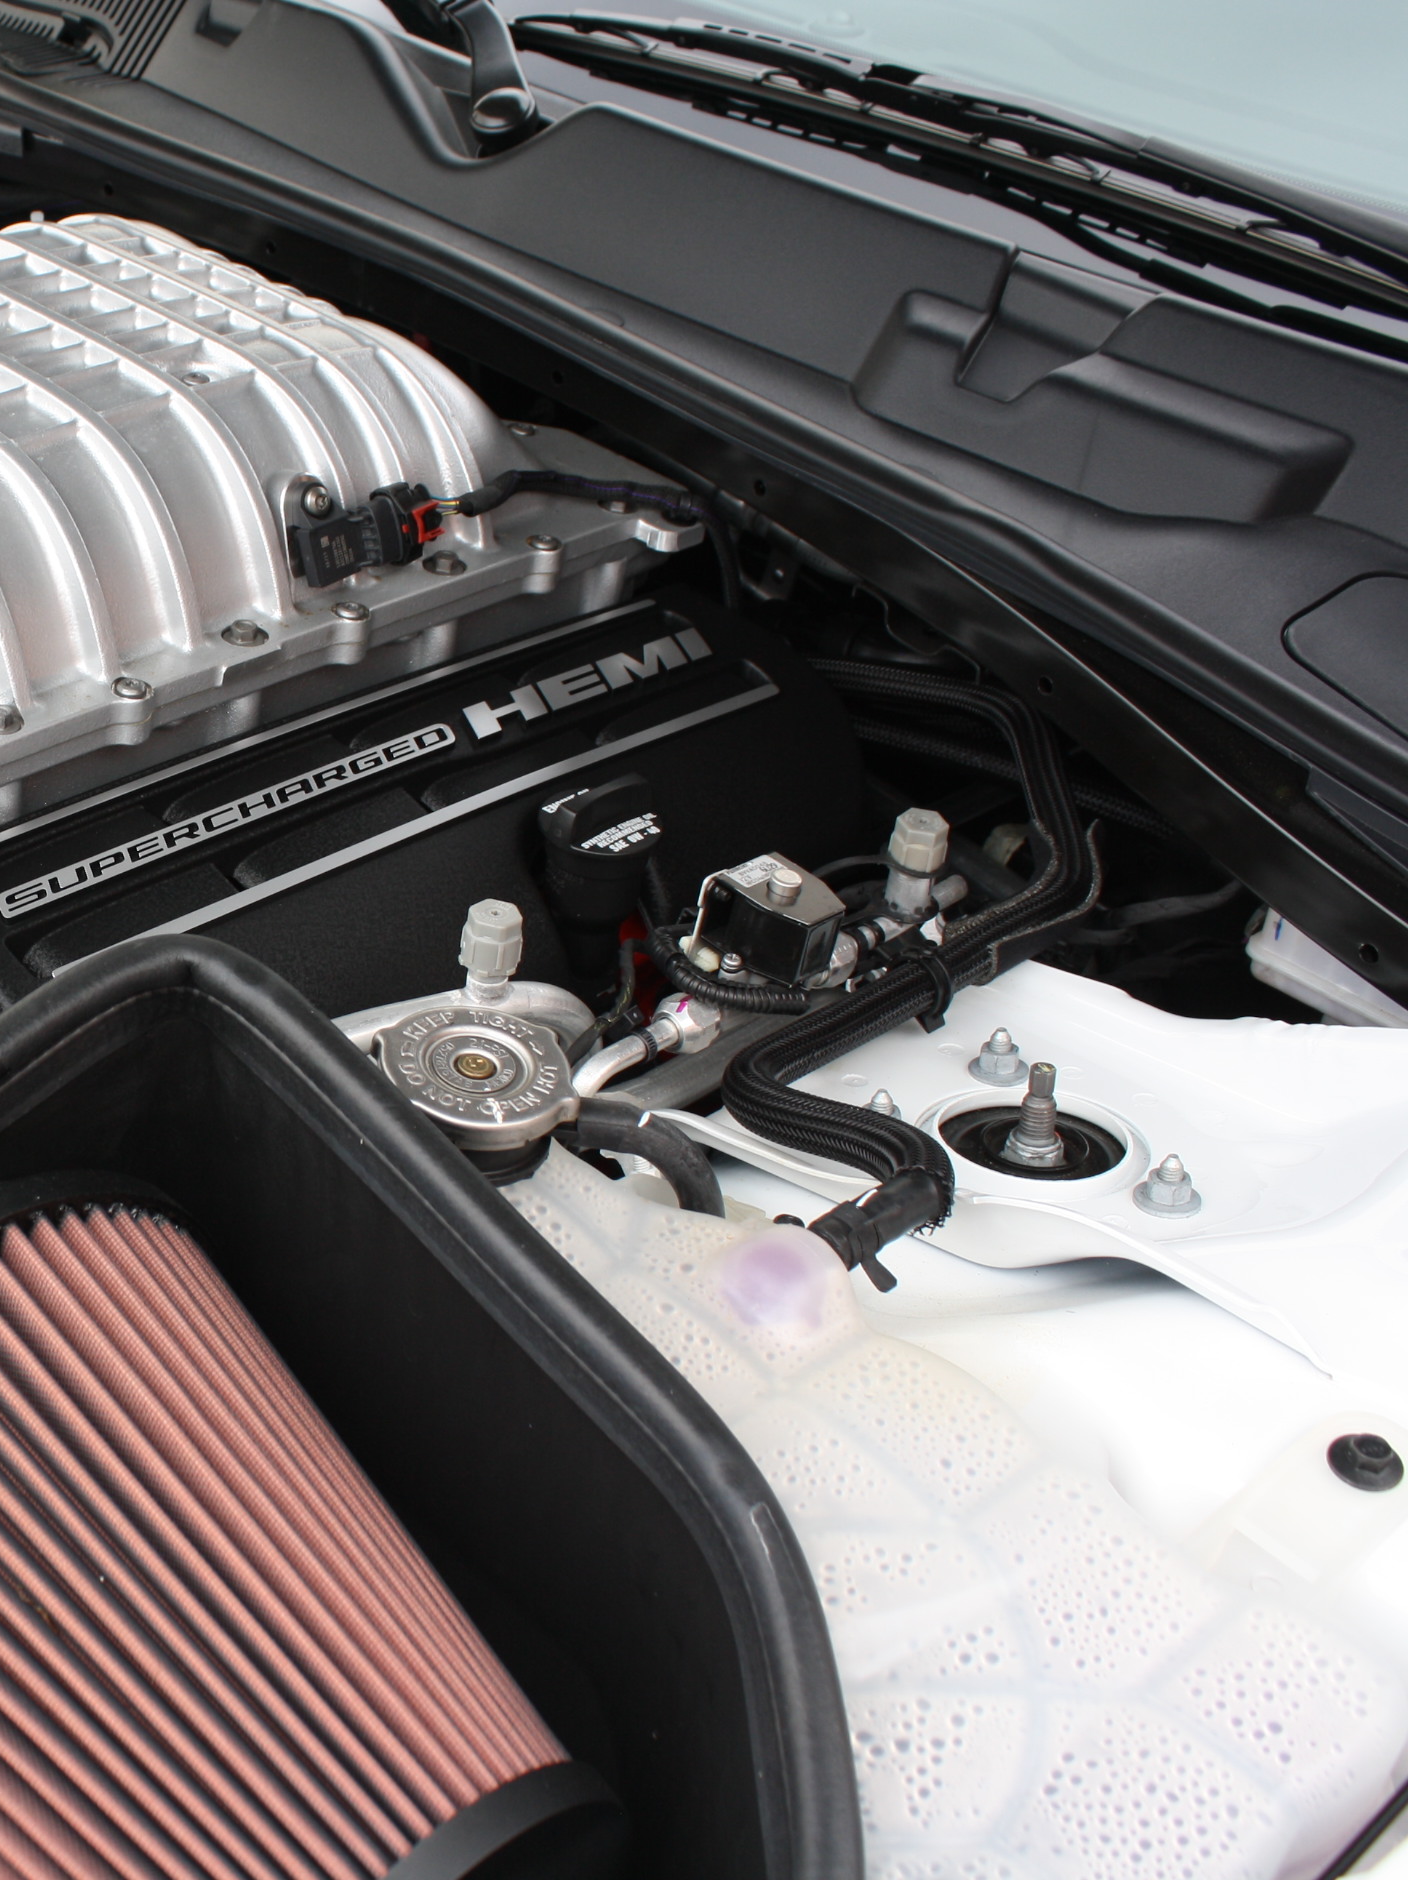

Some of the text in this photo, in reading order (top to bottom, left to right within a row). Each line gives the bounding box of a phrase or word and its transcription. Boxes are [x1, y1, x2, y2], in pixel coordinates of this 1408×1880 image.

[5, 627, 713, 912] SUPERCHARGED HEMI
[581, 826, 620, 849] SYNTHETIC
[617, 816, 645, 830] ENGINE
[596, 819, 653, 848] RECOMMENDED
[608, 839, 629, 852] SAE
[402, 1011, 535, 1041] KEEP TIGHT
[398, 1063, 426, 1086] DO
[422, 1086, 471, 1111] NOT
[476, 1091, 541, 1116] OPEN
[532, 1065, 558, 1095] HOT
